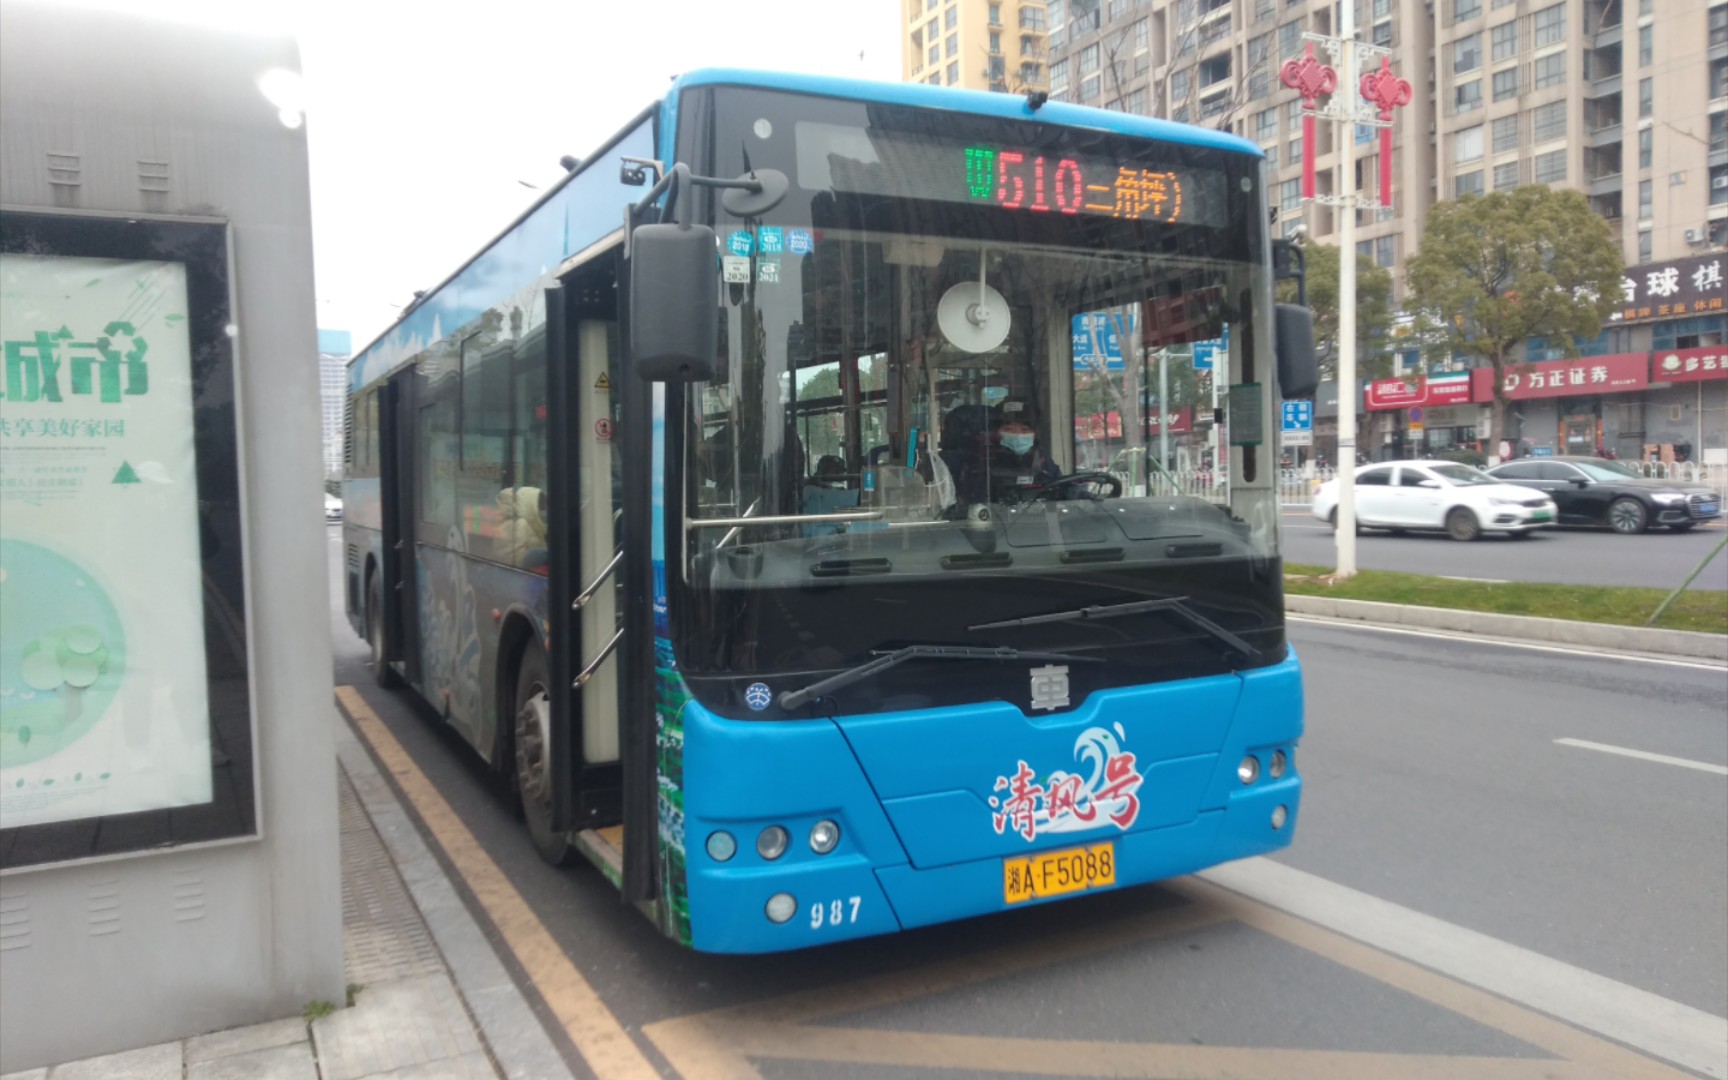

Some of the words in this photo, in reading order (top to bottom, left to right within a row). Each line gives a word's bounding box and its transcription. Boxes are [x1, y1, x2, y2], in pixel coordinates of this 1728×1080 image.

[997, 151, 1084, 214] 510
[726, 270, 749, 281] 2020
[0, 321, 148, 403] 城市
[1528, 366, 1609, 389] 方正证券
[988, 752, 1144, 842] 清风号
[810, 896, 861, 930] 987
